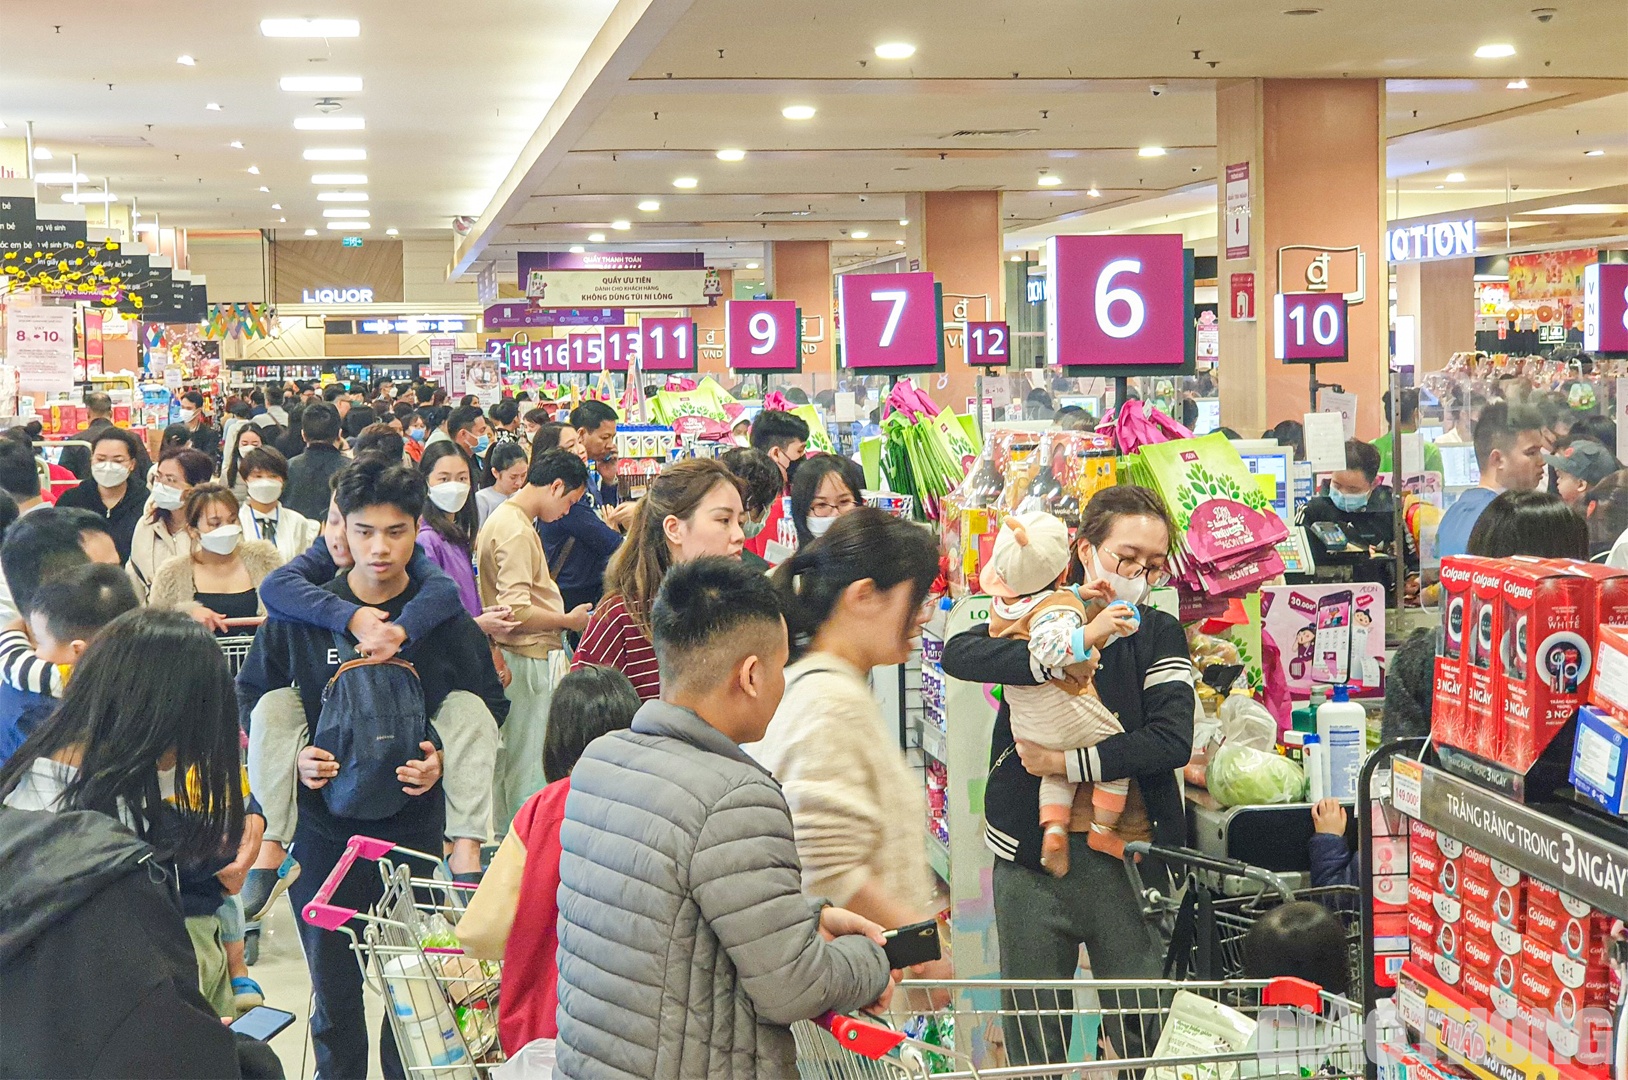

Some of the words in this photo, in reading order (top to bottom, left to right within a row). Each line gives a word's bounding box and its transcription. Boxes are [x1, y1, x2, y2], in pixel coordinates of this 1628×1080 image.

[303, 288, 373, 304] LIQUOR
[582, 292, 607, 300] KHÔNG
[1094, 259, 1145, 338] 6
[870, 290, 907, 347] 7
[1288, 304, 1339, 346] 10
[43, 331, 58, 342] 10
[650, 326, 687, 359] 11
[749, 312, 776, 354] 9
[947, 333, 966, 347] VN
[972, 328, 1005, 356] 12
[512, 349, 530, 366] 19
[544, 344, 568, 365] 16
[572, 339, 602, 363] 15
[608, 333, 640, 360] 13
[703, 350, 723, 358] VND
[802, 344, 817, 354] ND
[1442, 566, 1471, 582] Colgate
[1472, 572, 1500, 588] Colgate
[1504, 580, 1533, 599] Colgate
[327, 649, 342, 664] E
[1437, 678, 1442, 690] 3
[1442, 680, 1462, 695] NGÀY
[1469, 688, 1473, 699] 3
[1474, 689, 1492, 705] NGÀY
[1504, 699, 1509, 711] 3
[1510, 702, 1530, 718] NGÀY
[1546, 710, 1552, 718] 3
[1486, 766, 1491, 782] 3
[1491, 774, 1508, 788] NGÀY
[1412, 821, 1435, 840] Colgate
[1447, 792, 1482, 828] TRẮNG
[1483, 811, 1515, 846] RĂNG
[1517, 826, 1559, 864] TRONG
[1562, 832, 1576, 875] 3
[1578, 848, 1626, 898] NGÀY
[1464, 846, 1489, 866] Colgate
[1412, 851, 1435, 871] Colgate
[1408, 883, 1432, 902] Colgate
[1464, 877, 1489, 899] Colgate
[1408, 912, 1433, 934] Colgate
[1466, 910, 1491, 932] Colgate
[1529, 907, 1556, 929] Colgate
[1412, 942, 1433, 964] Colgate
[1465, 941, 1491, 964] Colgate
[1523, 939, 1551, 964] Colgate
[1465, 973, 1489, 995] Colgate
[1522, 973, 1550, 998] Colgate
[1517, 1006, 1545, 1031] Colgate
[1440, 1016, 1486, 1062] THẤP
